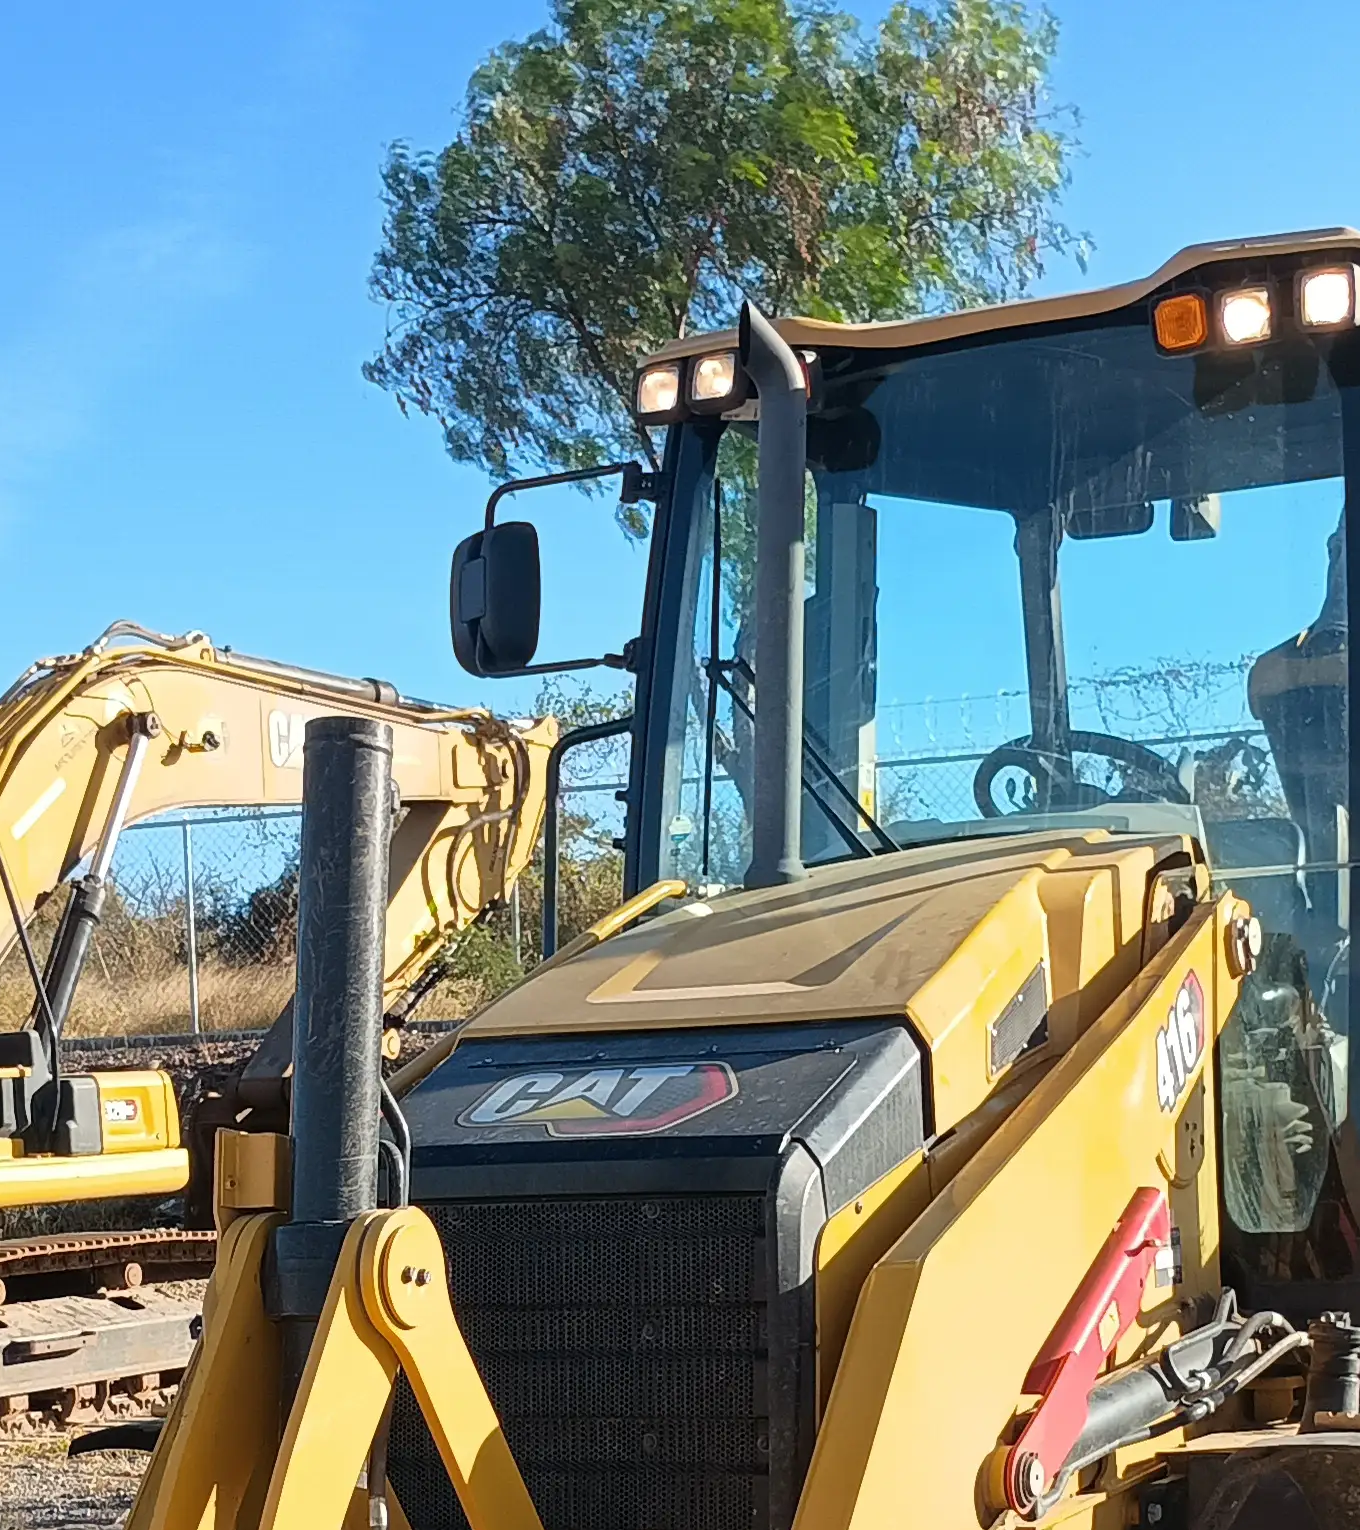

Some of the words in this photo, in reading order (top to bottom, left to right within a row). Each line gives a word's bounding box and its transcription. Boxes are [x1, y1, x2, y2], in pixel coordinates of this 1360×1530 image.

[268, 709, 306, 768] CA
[1156, 986, 1197, 1107] 416
[469, 1065, 697, 1123] CAT
